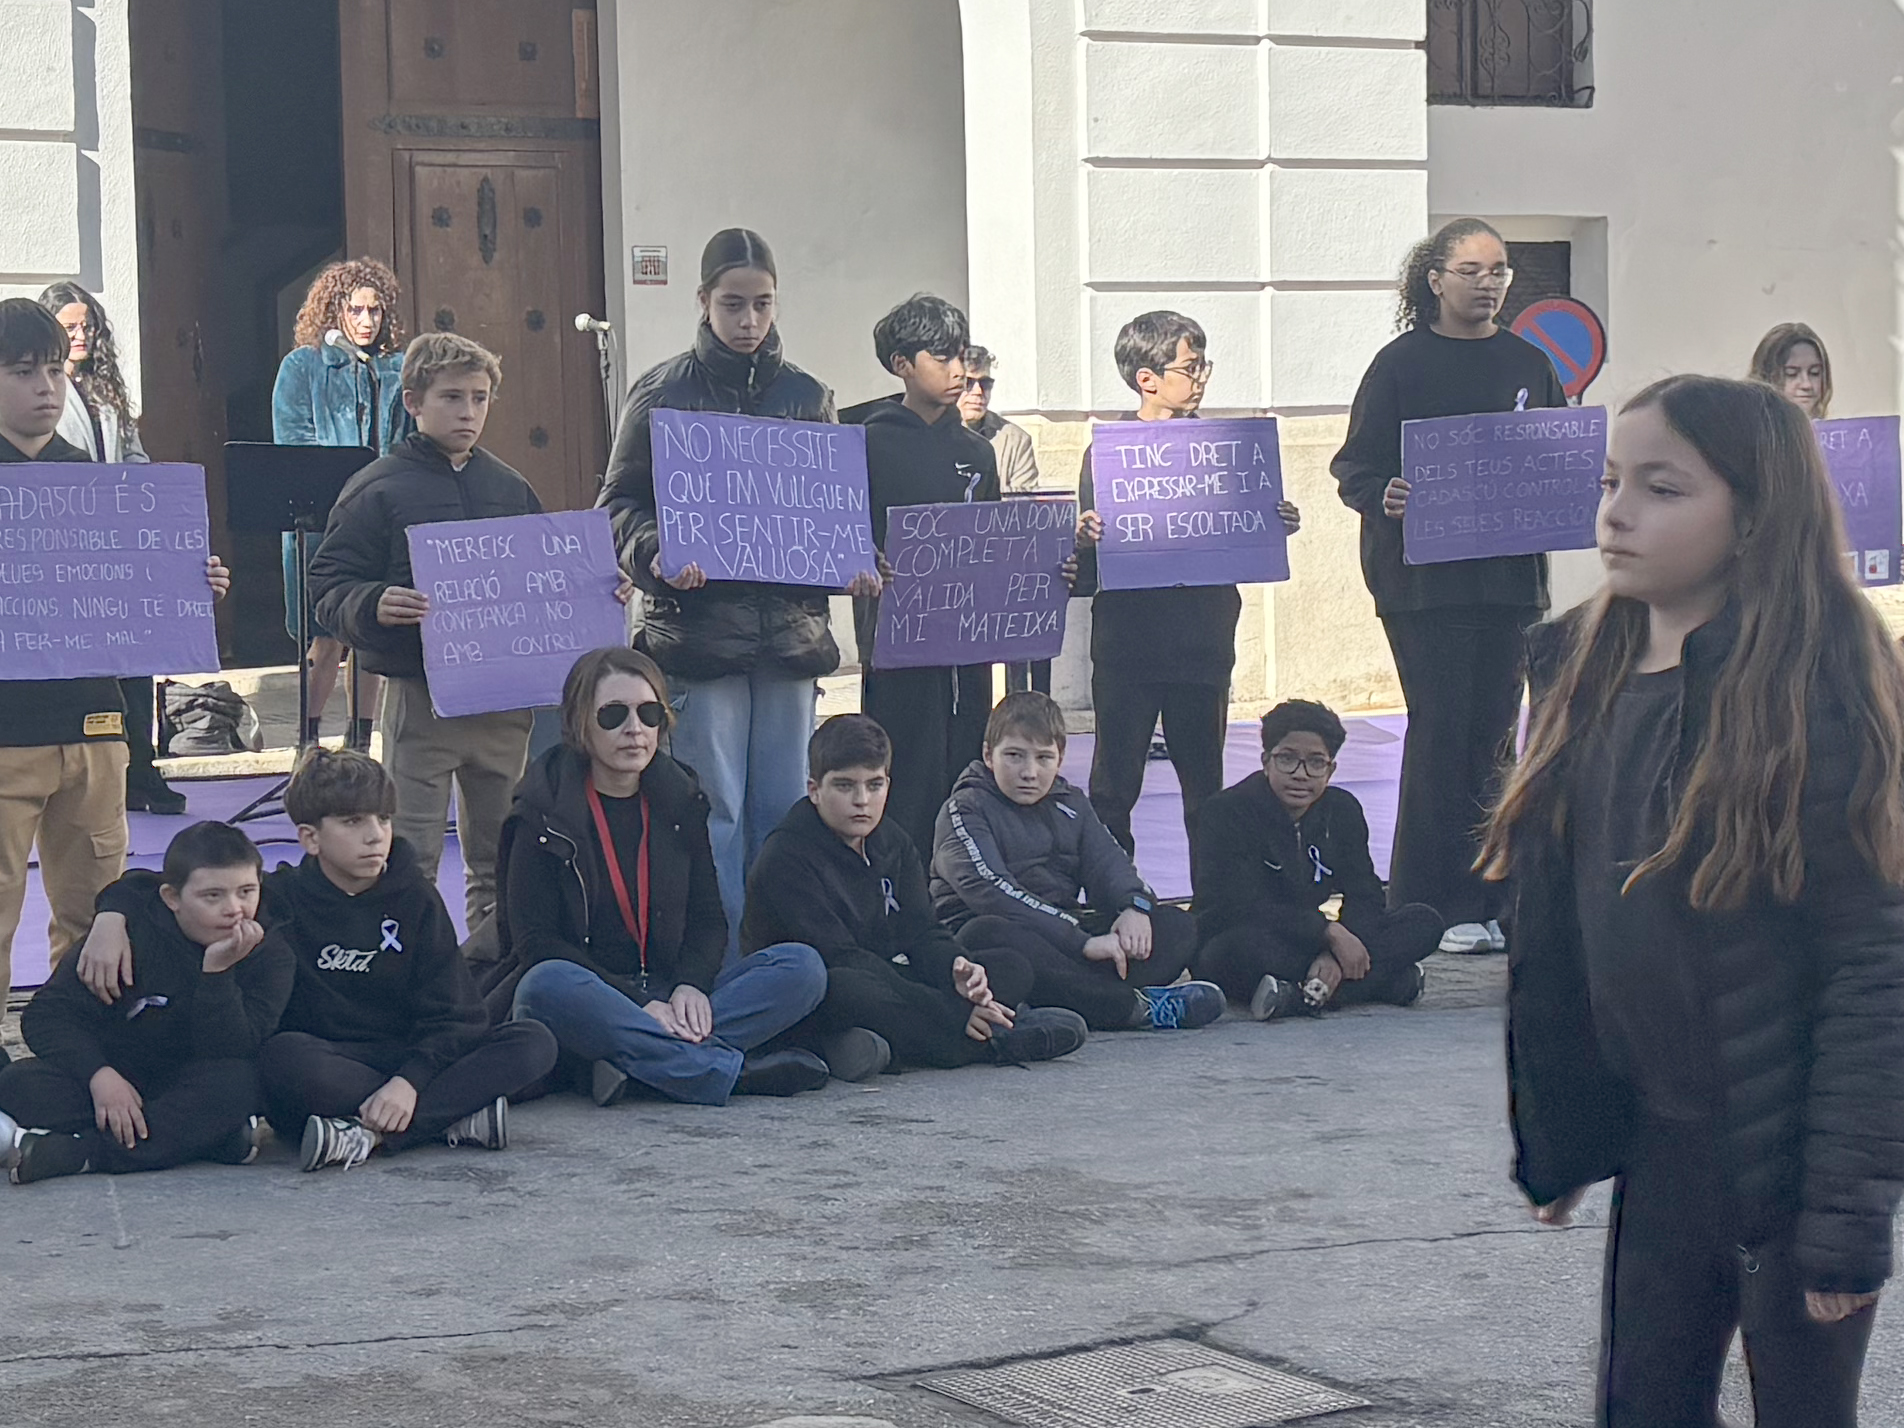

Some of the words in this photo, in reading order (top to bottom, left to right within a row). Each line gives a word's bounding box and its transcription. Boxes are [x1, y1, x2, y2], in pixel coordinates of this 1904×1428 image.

[720, 425, 838, 472] NECESSITE
[1413, 432, 1439, 450] NO
[1494, 420, 1600, 441] RESPONSABLE
[1859, 428, 1872, 449] A
[1115, 443, 1173, 468] TINC
[1189, 441, 1241, 466] DRET
[1253, 443, 1265, 465] A
[1415, 464, 1457, 482] DELS
[1465, 456, 1512, 476] TEUS
[1521, 450, 1594, 472] ACTES
[115, 471, 156, 514] ÉS
[668, 471, 715, 504] QUE
[727, 470, 760, 505] EM
[765, 472, 863, 512] VULLGUEN
[1112, 471, 1228, 502] EXPRESSAR-ME
[1237, 472, 1250, 493] I
[1259, 472, 1272, 489] A
[663, 506, 708, 545] PER
[719, 512, 870, 554] SENTIR-ME
[975, 504, 1021, 534] UNA
[1027, 503, 1075, 529] DONA
[1116, 514, 1154, 542] SER
[1167, 511, 1266, 538] ESCOLTADA
[138, 529, 161, 550] DE
[174, 529, 204, 550] LES
[542, 534, 582, 556] UNA
[895, 536, 1038, 576] COMPLETA
[1056, 537, 1068, 565] I
[56, 564, 133, 583] EMOCIONS
[434, 569, 501, 604] RELACIÓ
[526, 570, 566, 594] AMB
[1005, 573, 1050, 606] PER
[545, 602, 573, 620] NO
[15, 631, 93, 650] FER-ME
[891, 613, 928, 645] MI
[958, 610, 1059, 642] MATEIXA
[444, 641, 483, 666] AMB
